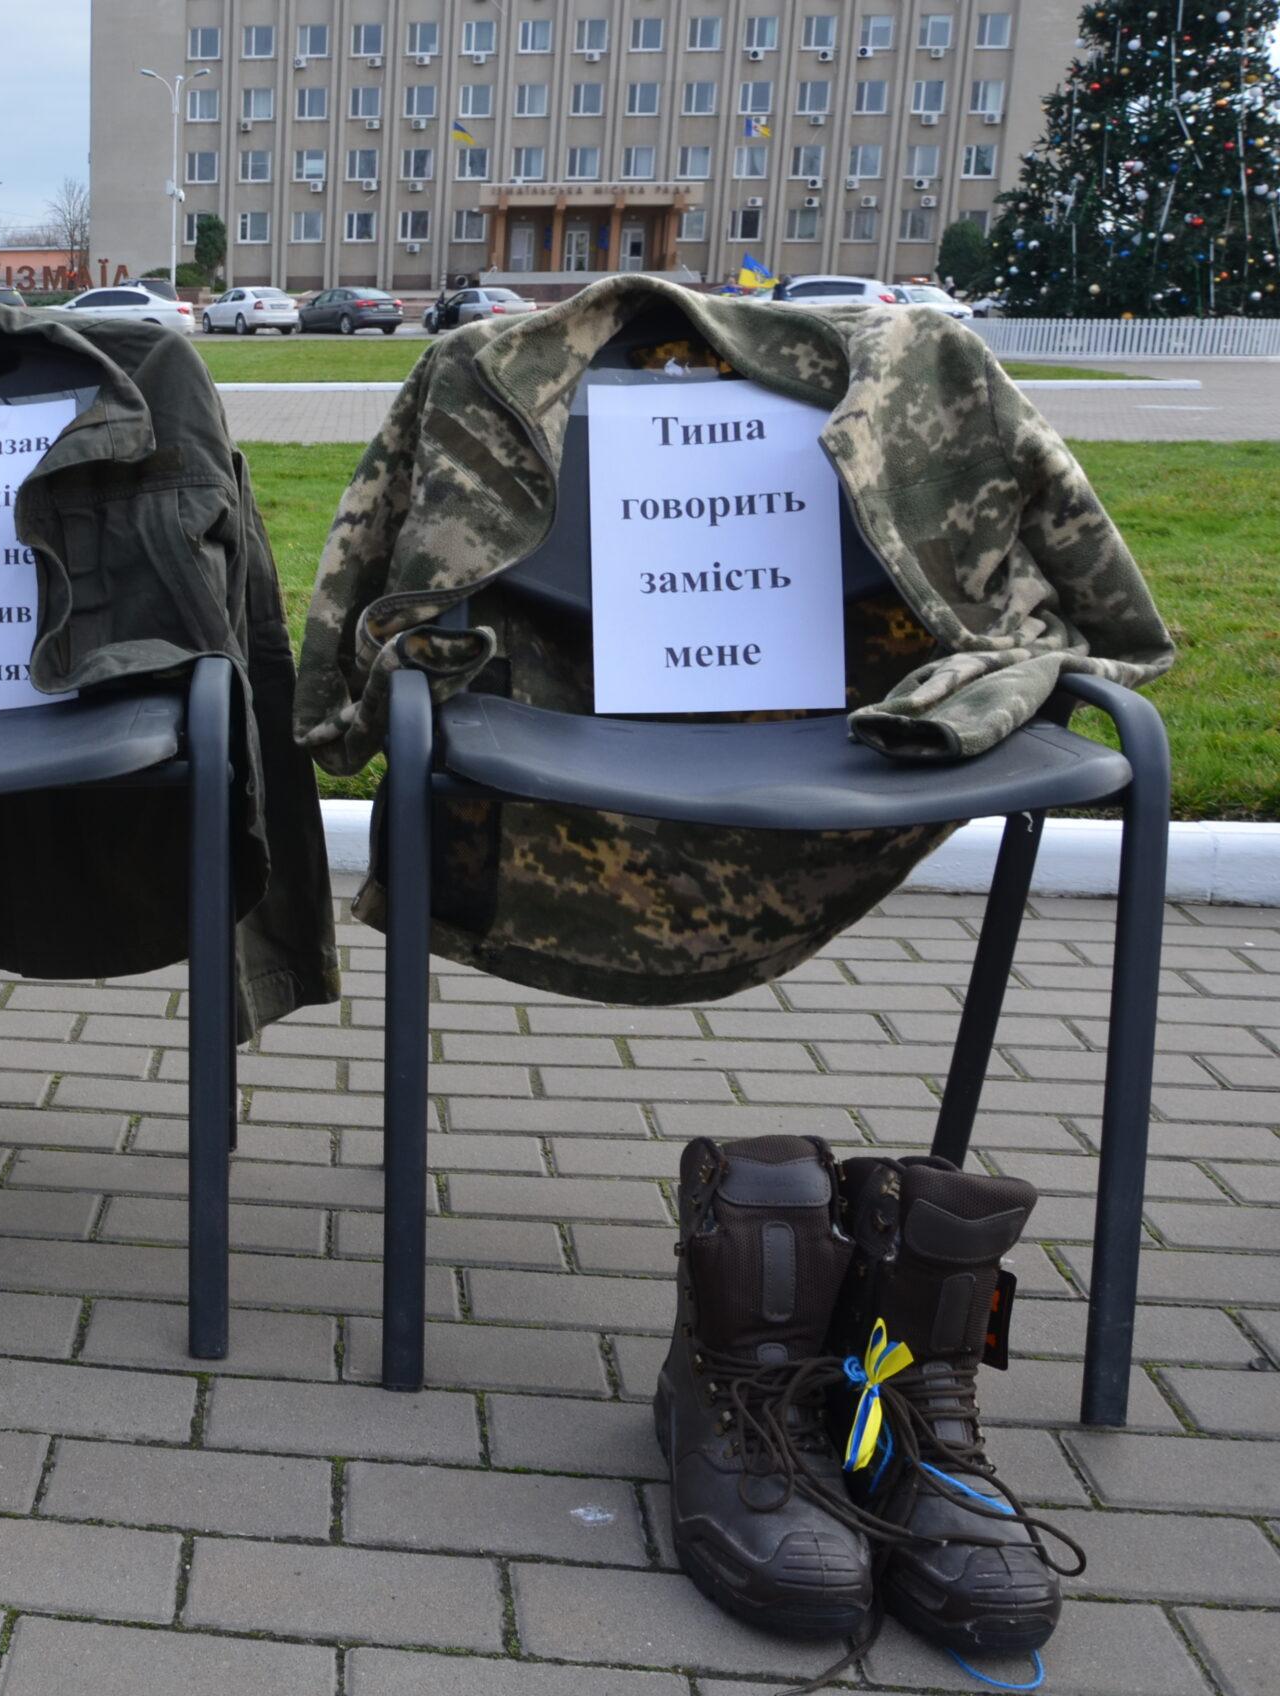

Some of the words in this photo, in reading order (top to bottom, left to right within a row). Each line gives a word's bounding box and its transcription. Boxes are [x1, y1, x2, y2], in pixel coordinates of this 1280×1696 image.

[652, 416, 766, 447] Тиша
[621, 490, 807, 527] говорить
[3, 547, 36, 566] не
[639, 561, 792, 595] замість
[664, 642, 763, 669] мене
